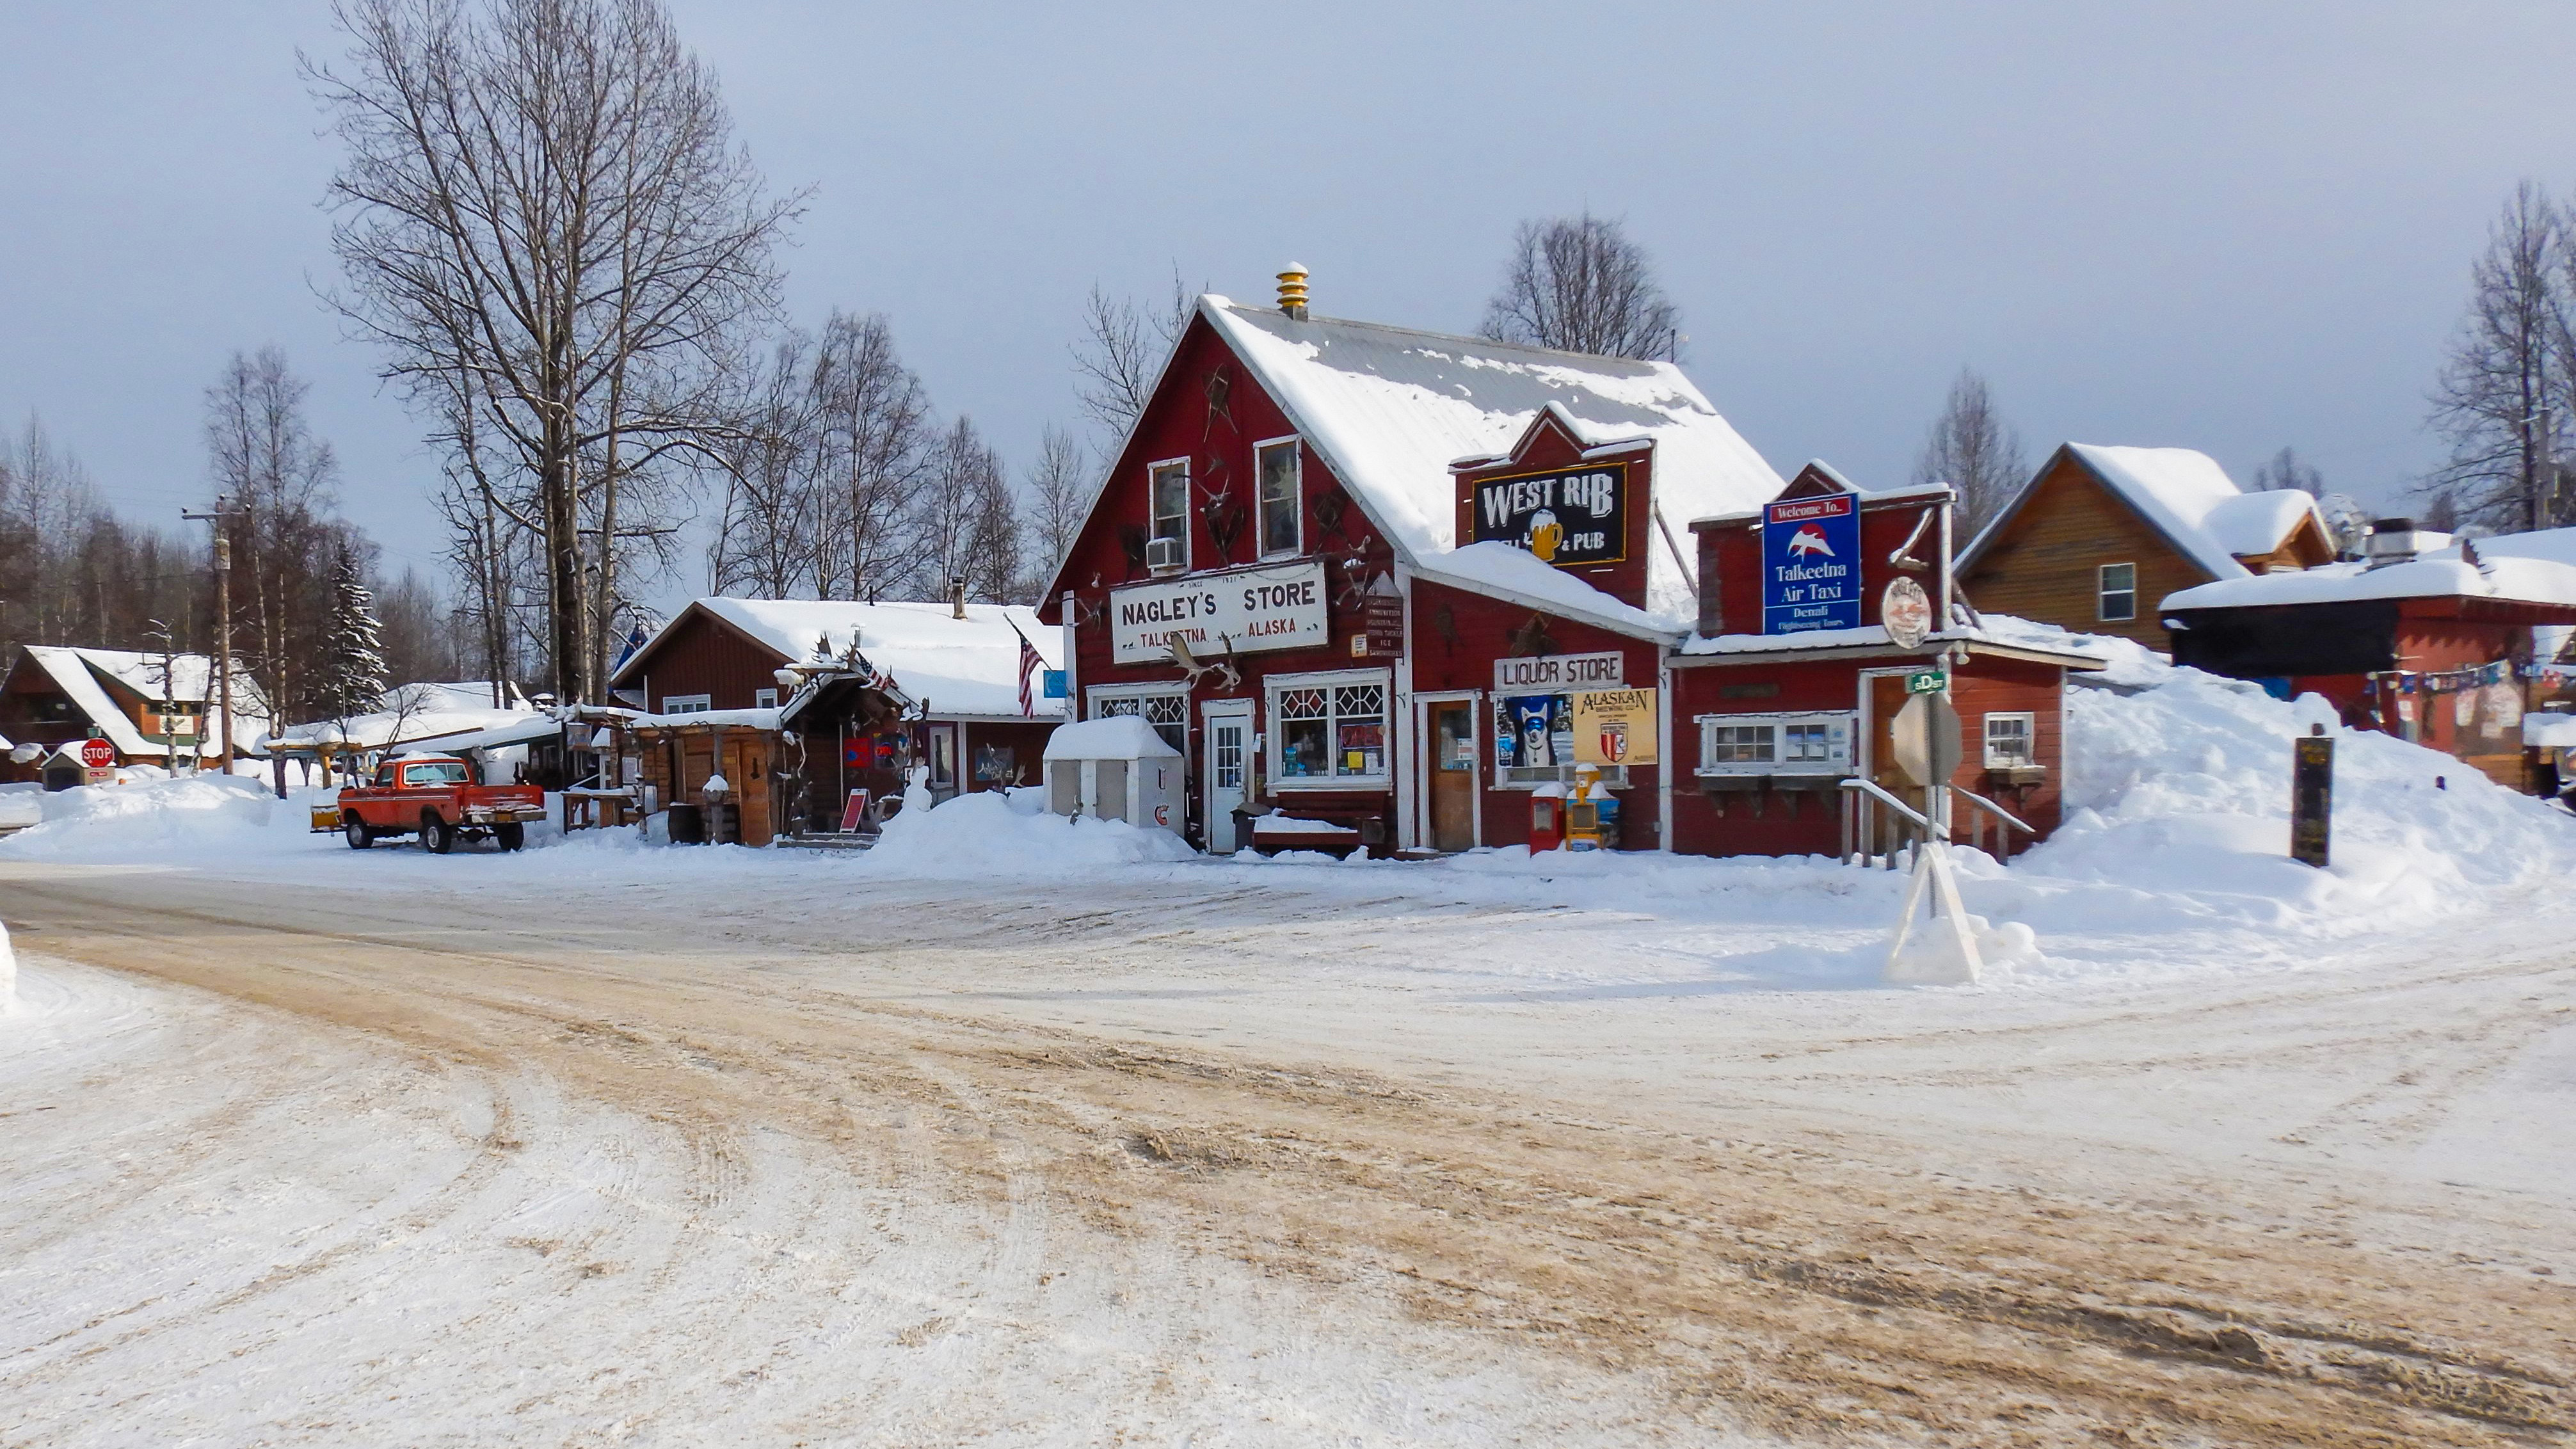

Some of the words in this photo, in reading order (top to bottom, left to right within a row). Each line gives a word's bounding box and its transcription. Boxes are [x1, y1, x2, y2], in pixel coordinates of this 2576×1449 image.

[1483, 479, 1556, 528] WEST
[1564, 474, 1613, 518] RIB
[1777, 506, 1821, 518] Welcome
[1574, 532, 1604, 551] PUB
[1775, 562, 1846, 582] Talkeetna
[1781, 586, 1804, 602] Air
[1809, 582, 1841, 600] Taxi
[1122, 591, 1216, 626] NAGLEY'S
[1244, 580, 1315, 611] STORE
[1794, 605, 1828, 618] Denali
[1140, 627, 1206, 648] TALKTNA
[1248, 617, 1296, 637] ALASKA
[1504, 661, 1559, 685] LIQUOR
[1567, 657, 1618, 682] STORE
[1580, 691, 1647, 715] ALASKAN
[84, 748, 111, 760] STOP
